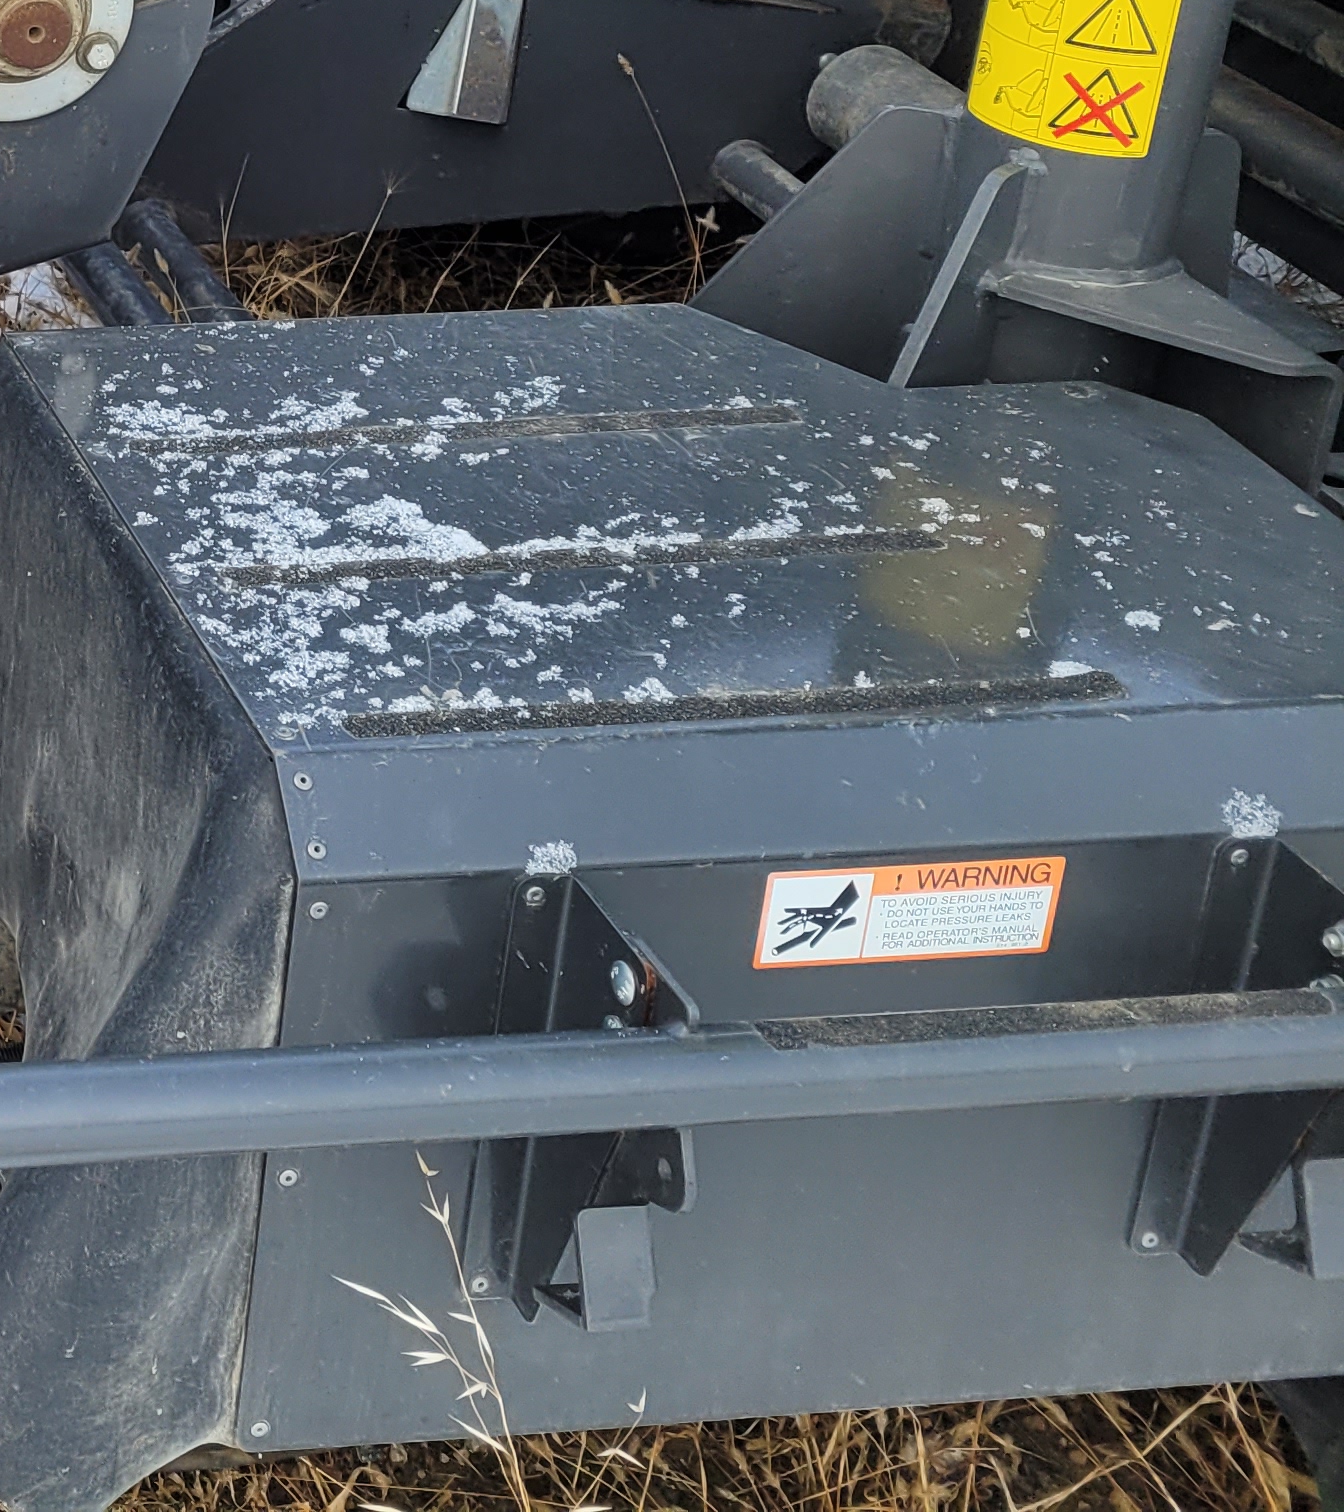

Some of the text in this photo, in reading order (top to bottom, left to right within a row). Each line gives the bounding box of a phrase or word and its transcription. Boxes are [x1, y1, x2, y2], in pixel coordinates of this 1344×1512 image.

[917, 862, 1052, 890] WARNING
[881, 890, 1044, 908] TO AVOID SERIOUS INJURY
[887, 901, 1044, 918] DO NOT USE YOUR HANDS TO
[884, 912, 1031, 929] LOCATE PRESSURE LEAKS
[882, 924, 1038, 941] READ OPERATOR'S MANUAL
[881, 933, 1039, 950] FOR ADDITIONAL INSTRUCTION
